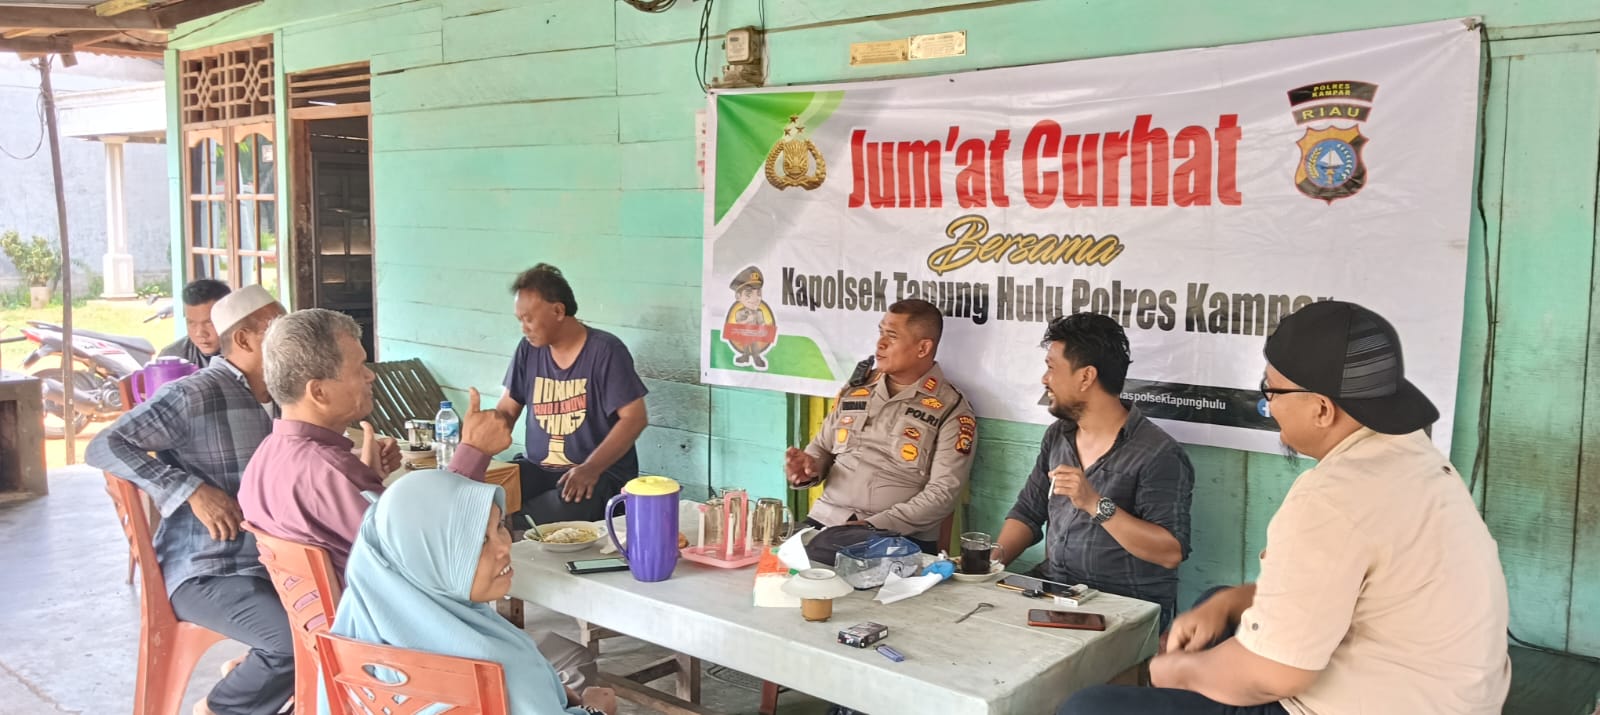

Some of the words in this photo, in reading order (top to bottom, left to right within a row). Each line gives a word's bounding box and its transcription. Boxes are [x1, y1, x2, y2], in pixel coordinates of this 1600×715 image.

[1312, 90, 1351, 98] KAMPAR
[1313, 83, 1351, 92] POLRES
[1302, 106, 1360, 120] RIAU
[848, 126, 1011, 209] Jum'at
[1022, 114, 1242, 209] Curhat
[927, 214, 1125, 275] Bersama
[781, 267, 888, 312] Kapolsek
[996, 276, 1064, 322] Hulu
[1072, 278, 1177, 331] Polres
[543, 377, 587, 402] DRINK
[560, 394, 586, 414] KNOW
[535, 409, 587, 435] THINGS
[904, 407, 939, 427] POLRI
